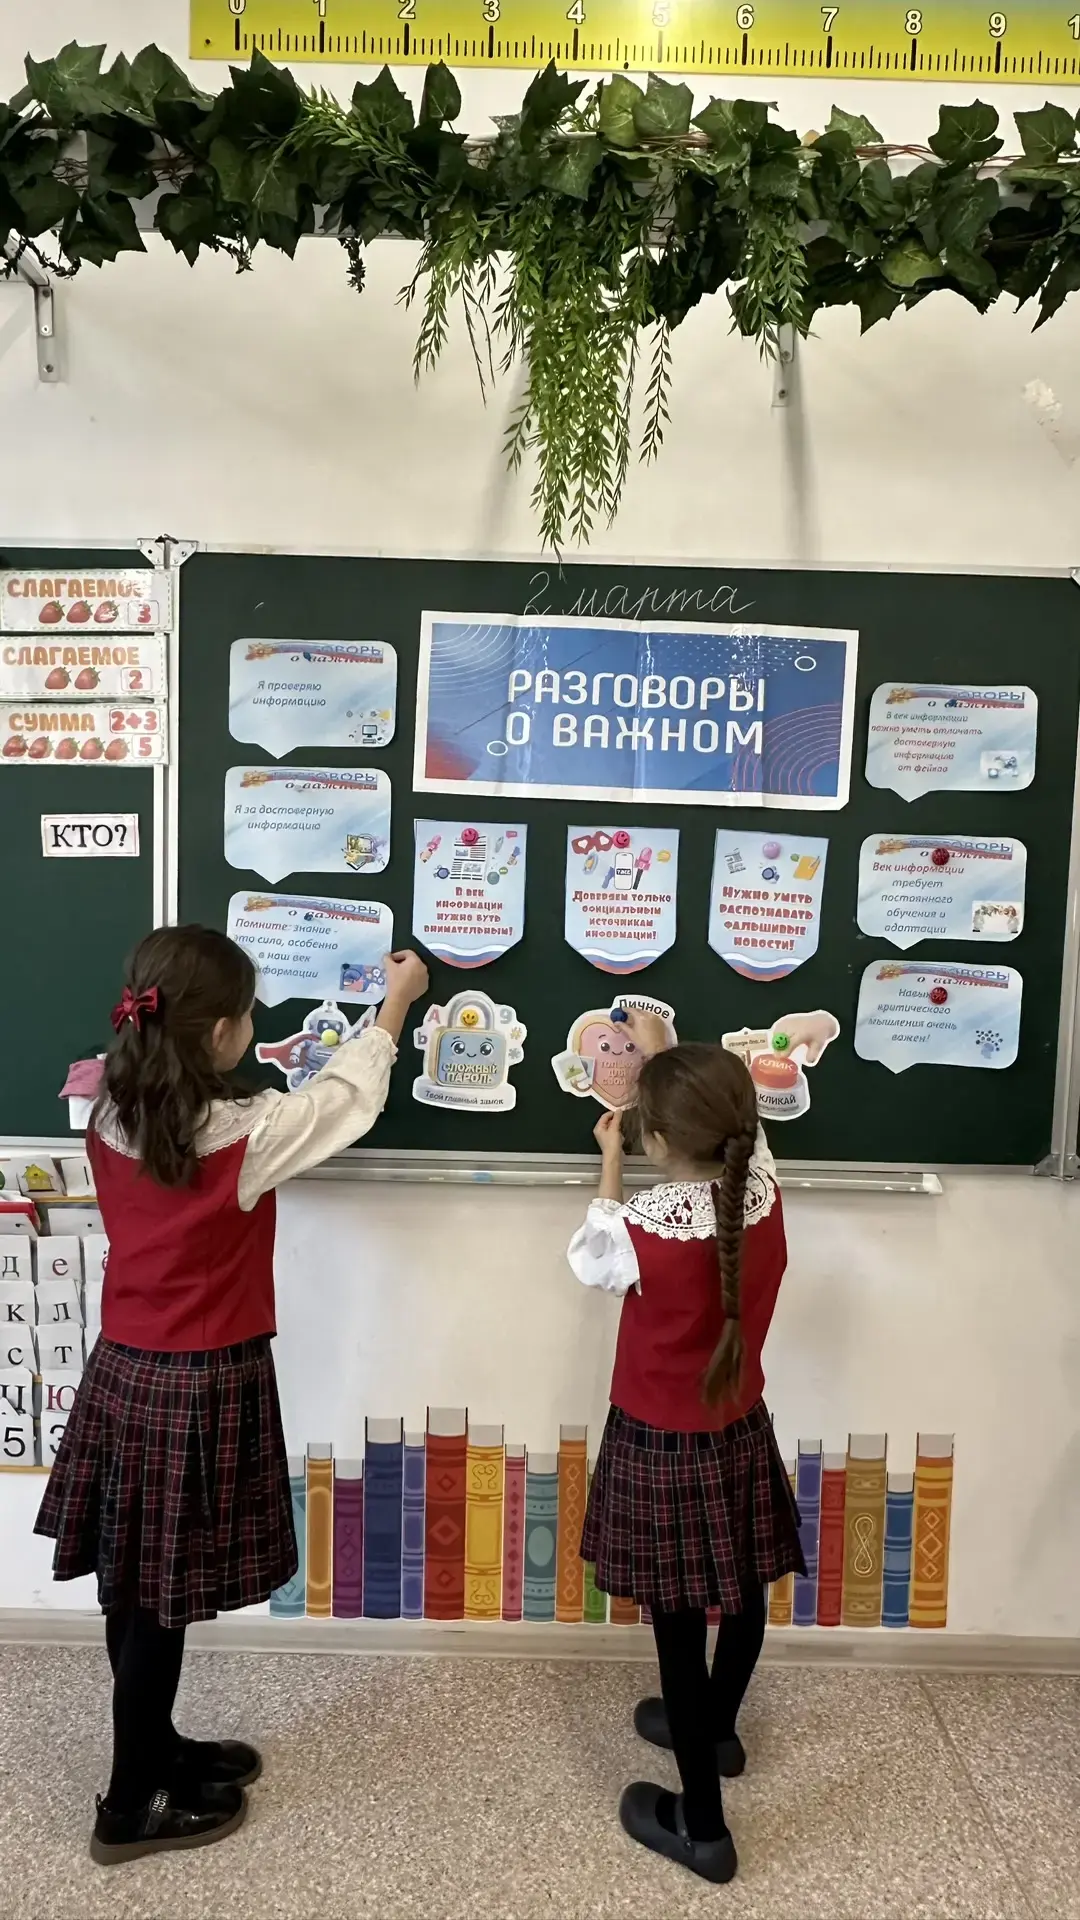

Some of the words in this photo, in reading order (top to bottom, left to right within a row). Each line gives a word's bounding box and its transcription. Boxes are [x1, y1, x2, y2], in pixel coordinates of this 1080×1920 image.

[398, 0, 416, 20] 2
[483, 0, 501, 22] 3
[566, 0, 585, 25] 4
[651, 2, 670, 28] 5
[735, 4, 755, 30] 6
[820, 7, 840, 32] 7
[904, 10, 923, 35] 8
[988, 12, 1007, 38] 9
[523, 571, 551, 615] 2
[563, 585, 757, 620] марта
[137, 603, 152, 623] 3
[3, 646, 140, 666] СЛАГАЕМОЕ
[129, 670, 144, 690] 2
[257, 681, 265, 689] Я
[267, 682, 322, 692] проверяю
[508, 669, 766, 712] РАЗГОВОРЫ
[252, 696, 326, 707] информацию
[8, 712, 95, 732] СУММА
[111, 710, 158, 731] 2+3
[506, 711, 531, 746] О
[553, 713, 764, 754] ВАЖНОМ
[139, 737, 153, 757] 5
[234, 804, 242, 814] Я
[244, 806, 256, 814] за
[259, 804, 335, 817] достоверную
[247, 820, 321, 831] информацию
[50, 824, 127, 848] КТО?
[872, 862, 892, 872] Век
[894, 863, 964, 876] информации
[892, 879, 943, 890] требует
[881, 895, 953, 904] постоянного
[887, 908, 937, 919] обучения
[235, 918, 292, 931] Помните:
[293, 924, 332, 935] знание
[884, 924, 947, 935] адаптации
[257, 936, 285, 948] сила,
[287, 938, 339, 950] особенно
[267, 952, 290, 961] наш
[292, 955, 311, 963] век
[259, 965, 319, 979] формации
[619, 999, 670, 1019] Личное
[877, 1004, 951, 1014] критического
[868, 1018, 924, 1028] мышления
[926, 1021, 957, 1030] очень
[892, 1034, 931, 1042] важен!
[759, 1058, 795, 1071] КЛИК
[758, 1094, 797, 1105] КЛИКАЙ
[52, 1257, 69, 1276] е
[3, 1427, 26, 1457] 5
